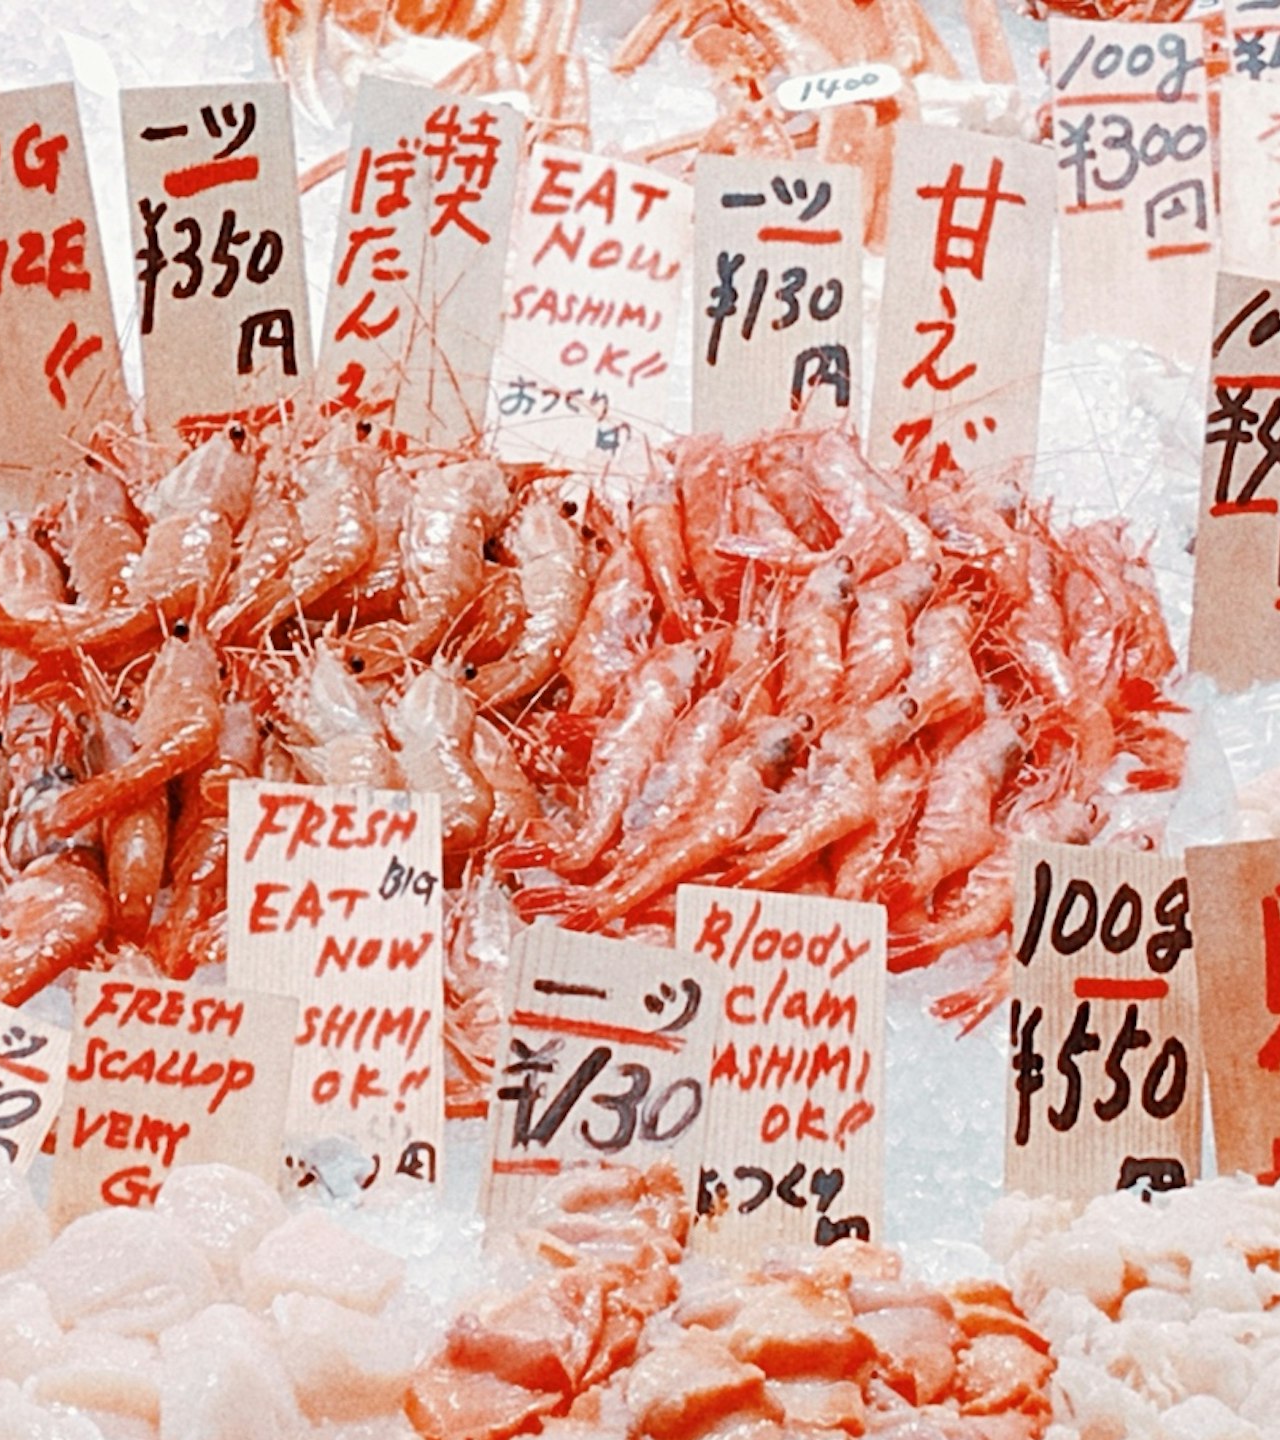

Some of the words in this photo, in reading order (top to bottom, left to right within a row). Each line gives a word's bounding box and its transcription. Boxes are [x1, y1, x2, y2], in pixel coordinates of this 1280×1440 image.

[801, 72, 879, 101] 1400
[1056, 33, 1205, 101] 100g
[140, 102, 257, 160] 一ツ
[1058, 115, 1207, 209] ¥300
[424, 104, 502, 244] 特大
[531, 158, 669, 225] EAT
[721, 177, 832, 222] 一ツ
[1145, 178, 1208, 238] 円
[136, 198, 283, 335] ¥350
[532, 222, 681, 281] NOW
[507, 284, 662, 332] SASHIMI
[706, 251, 844, 366] ¥130
[237, 309, 298, 375] 円
[791, 344, 851, 411] 円
[244, 793, 418, 862] FRESH
[249, 880, 371, 934] EAT
[1016, 860, 1193, 973] 100g
[315, 932, 434, 979] NOW
[83, 982, 245, 1038] FRESH
[533, 978, 702, 1033] 一ツ
[724, 967, 858, 1034] Clam
[497, 1037, 704, 1151] ¥130
[1011, 999, 1188, 1147] ¥550
[72, 1107, 191, 1168] VERY
